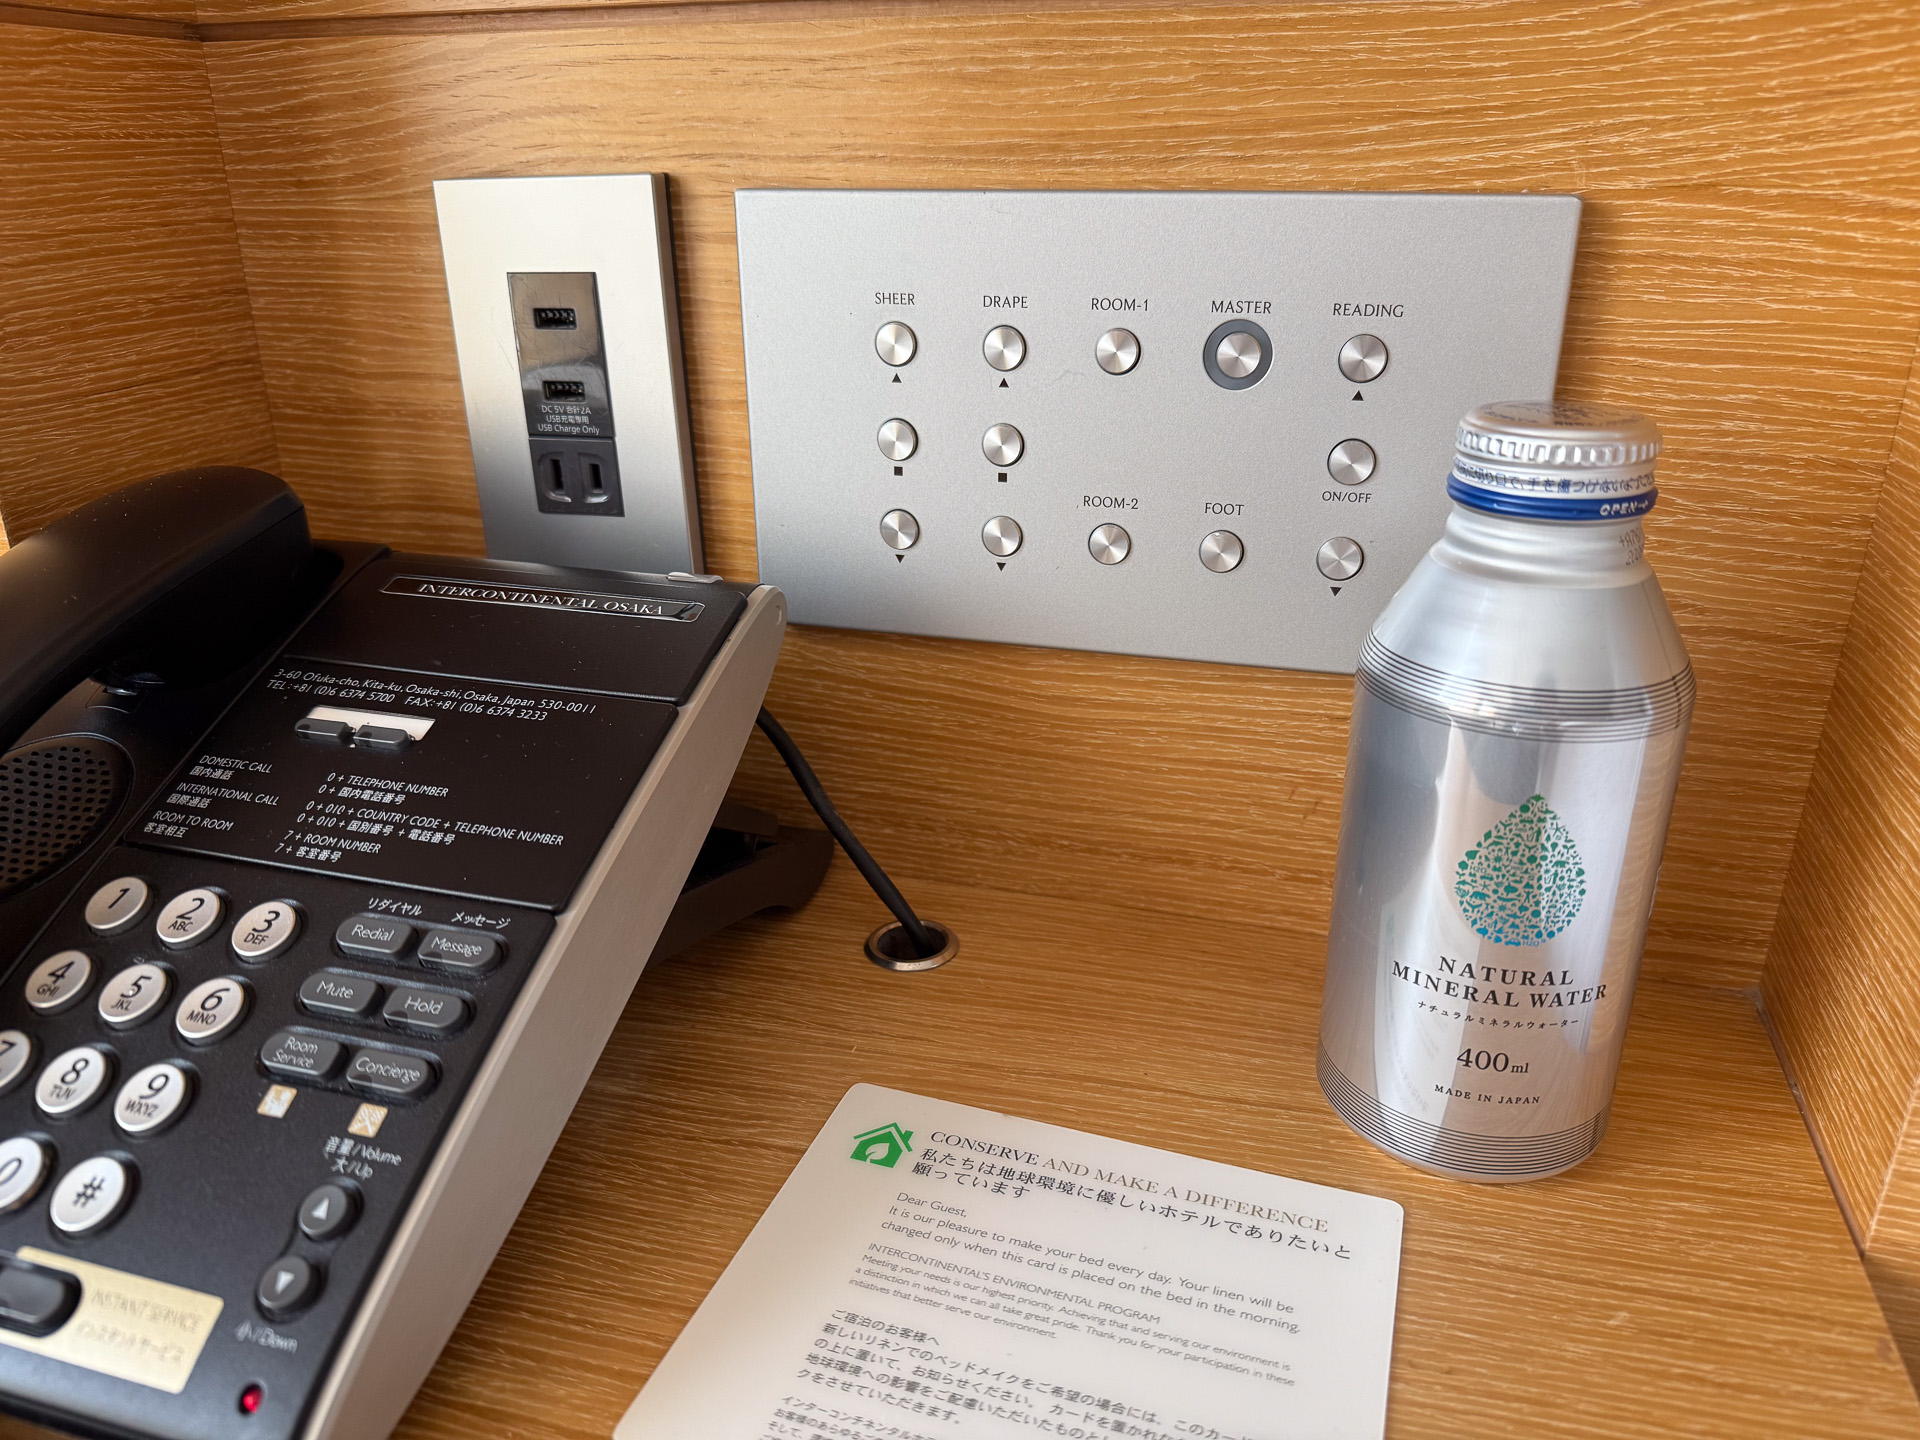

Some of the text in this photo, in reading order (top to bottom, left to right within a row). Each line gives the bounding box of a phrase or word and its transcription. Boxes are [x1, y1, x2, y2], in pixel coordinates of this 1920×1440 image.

[874, 292, 916, 306] SHEER
[983, 295, 1029, 309] DRAPE
[1091, 298, 1149, 312] ROOM-1
[1211, 300, 1272, 315] MASTER
[1332, 303, 1405, 318] READING
[541, 405, 552, 413] DC
[554, 405, 565, 414] 5V
[537, 423, 600, 436] USB Charge Only
[1082, 495, 1139, 510] ROOM-2
[1322, 491, 1372, 504] ON/OFF
[1204, 502, 1245, 516] FOOT
[1599, 501, 1638, 516] OPEN
[418, 583, 664, 616] INTERCONTINENTAL OSAKA
[274, 668, 596, 714] 3-60 Ofuka-cho, Kita-ku, Osaka-shi, Osaka, Japan 530-0011
[313, 683, 337, 698] (0)6
[339, 686, 366, 700] 6374
[366, 690, 396, 703] 5700
[459, 701, 484, 715] (0)6
[486, 705, 515, 717] 6374
[516, 708, 548, 721] 3233
[190, 765, 234, 781] 国内通話
[199, 755, 274, 774] DOMESTIC CALL
[176, 782, 280, 806] INTERNATIONAL CALL
[337, 786, 406, 805] 国内電話番号
[347, 775, 449, 797] TELEPHONE NUMBER
[166, 793, 212, 809] 国際通話
[143, 822, 189, 838] 客室相互
[152, 810, 234, 831] ROOM ROOM
[316, 815, 456, 846] 010 国別番号 電話番号
[325, 803, 564, 846] 010 COUNTRY CODE TELEPHONE NUMBER
[303, 832, 382, 854] ROOM NUMBER
[295, 845, 342, 863] 客室番号
[108, 887, 131, 909] 1
[368, 898, 422, 916] リダイヤル
[175, 897, 205, 921] 2
[167, 920, 193, 933] ABC
[251, 910, 280, 933] 3
[451, 911, 511, 929] メッセージ
[243, 932, 269, 946] DEF
[351, 924, 395, 942] Redial
[431, 936, 483, 958] Message
[47, 960, 75, 985] 4
[1438, 956, 1574, 987] NATURAL
[36, 984, 60, 998] GHI
[120, 975, 152, 999] 5
[316, 980, 354, 1000] Mute
[1392, 960, 1607, 1008] MINERAL WATER
[110, 998, 132, 1012] JKL
[200, 987, 230, 1012] 6
[404, 997, 444, 1015] Hold
[186, 1010, 217, 1026] MNO
[1417, 1001, 1579, 1029] ナチュラルミネラルウォーター
[284, 1036, 319, 1054] Room
[272, 1049, 314, 1069] Service
[355, 1056, 421, 1083] Concierge
[60, 1058, 89, 1085] 8
[50, 1083, 77, 1100] TUV
[138, 1073, 170, 1100] 9
[1434, 1084, 1540, 1104] MADE IN JAPAN
[125, 1098, 160, 1119] WXYZ
[911, 1161, 1030, 1199] 願っています
[931, 1131, 1328, 1233] CONSERVE AND MAKE A DIFFERENCE
[72, 1175, 104, 1209] #
[897, 1192, 928, 1208] Dear
[920, 1148, 1351, 1260] 私たちは地球環境に優しいホテルでありたいと
[881, 1220, 932, 1240] changed
[933, 1234, 962, 1249] only
[963, 1240, 997, 1258] when
[1001, 1249, 1023, 1264] this
[1026, 1255, 1055, 1271] card
[1071, 1269, 1115, 1287] placed
[1118, 1281, 1136, 1292] on
[1140, 1284, 1162, 1299] the
[1166, 1290, 1193, 1306] bed
[1213, 1302, 1236, 1316] the
[936, 1218, 1294, 1314] pleasure make your bed every day. Your linen will be
[849, 1277, 972, 1316] initiatives that better serve
[992, 1275, 1094, 1308] ENVIRONMENTAL
[1097, 1301, 1161, 1325] PROGRAM
[862, 1254, 1279, 1368] Meeting your needs highest Achieving that serving environment
[831, 1308, 941, 1346] ご宿泊のお客様へ
[863, 1269, 1295, 1387] distinction which take great Thank your participation these
